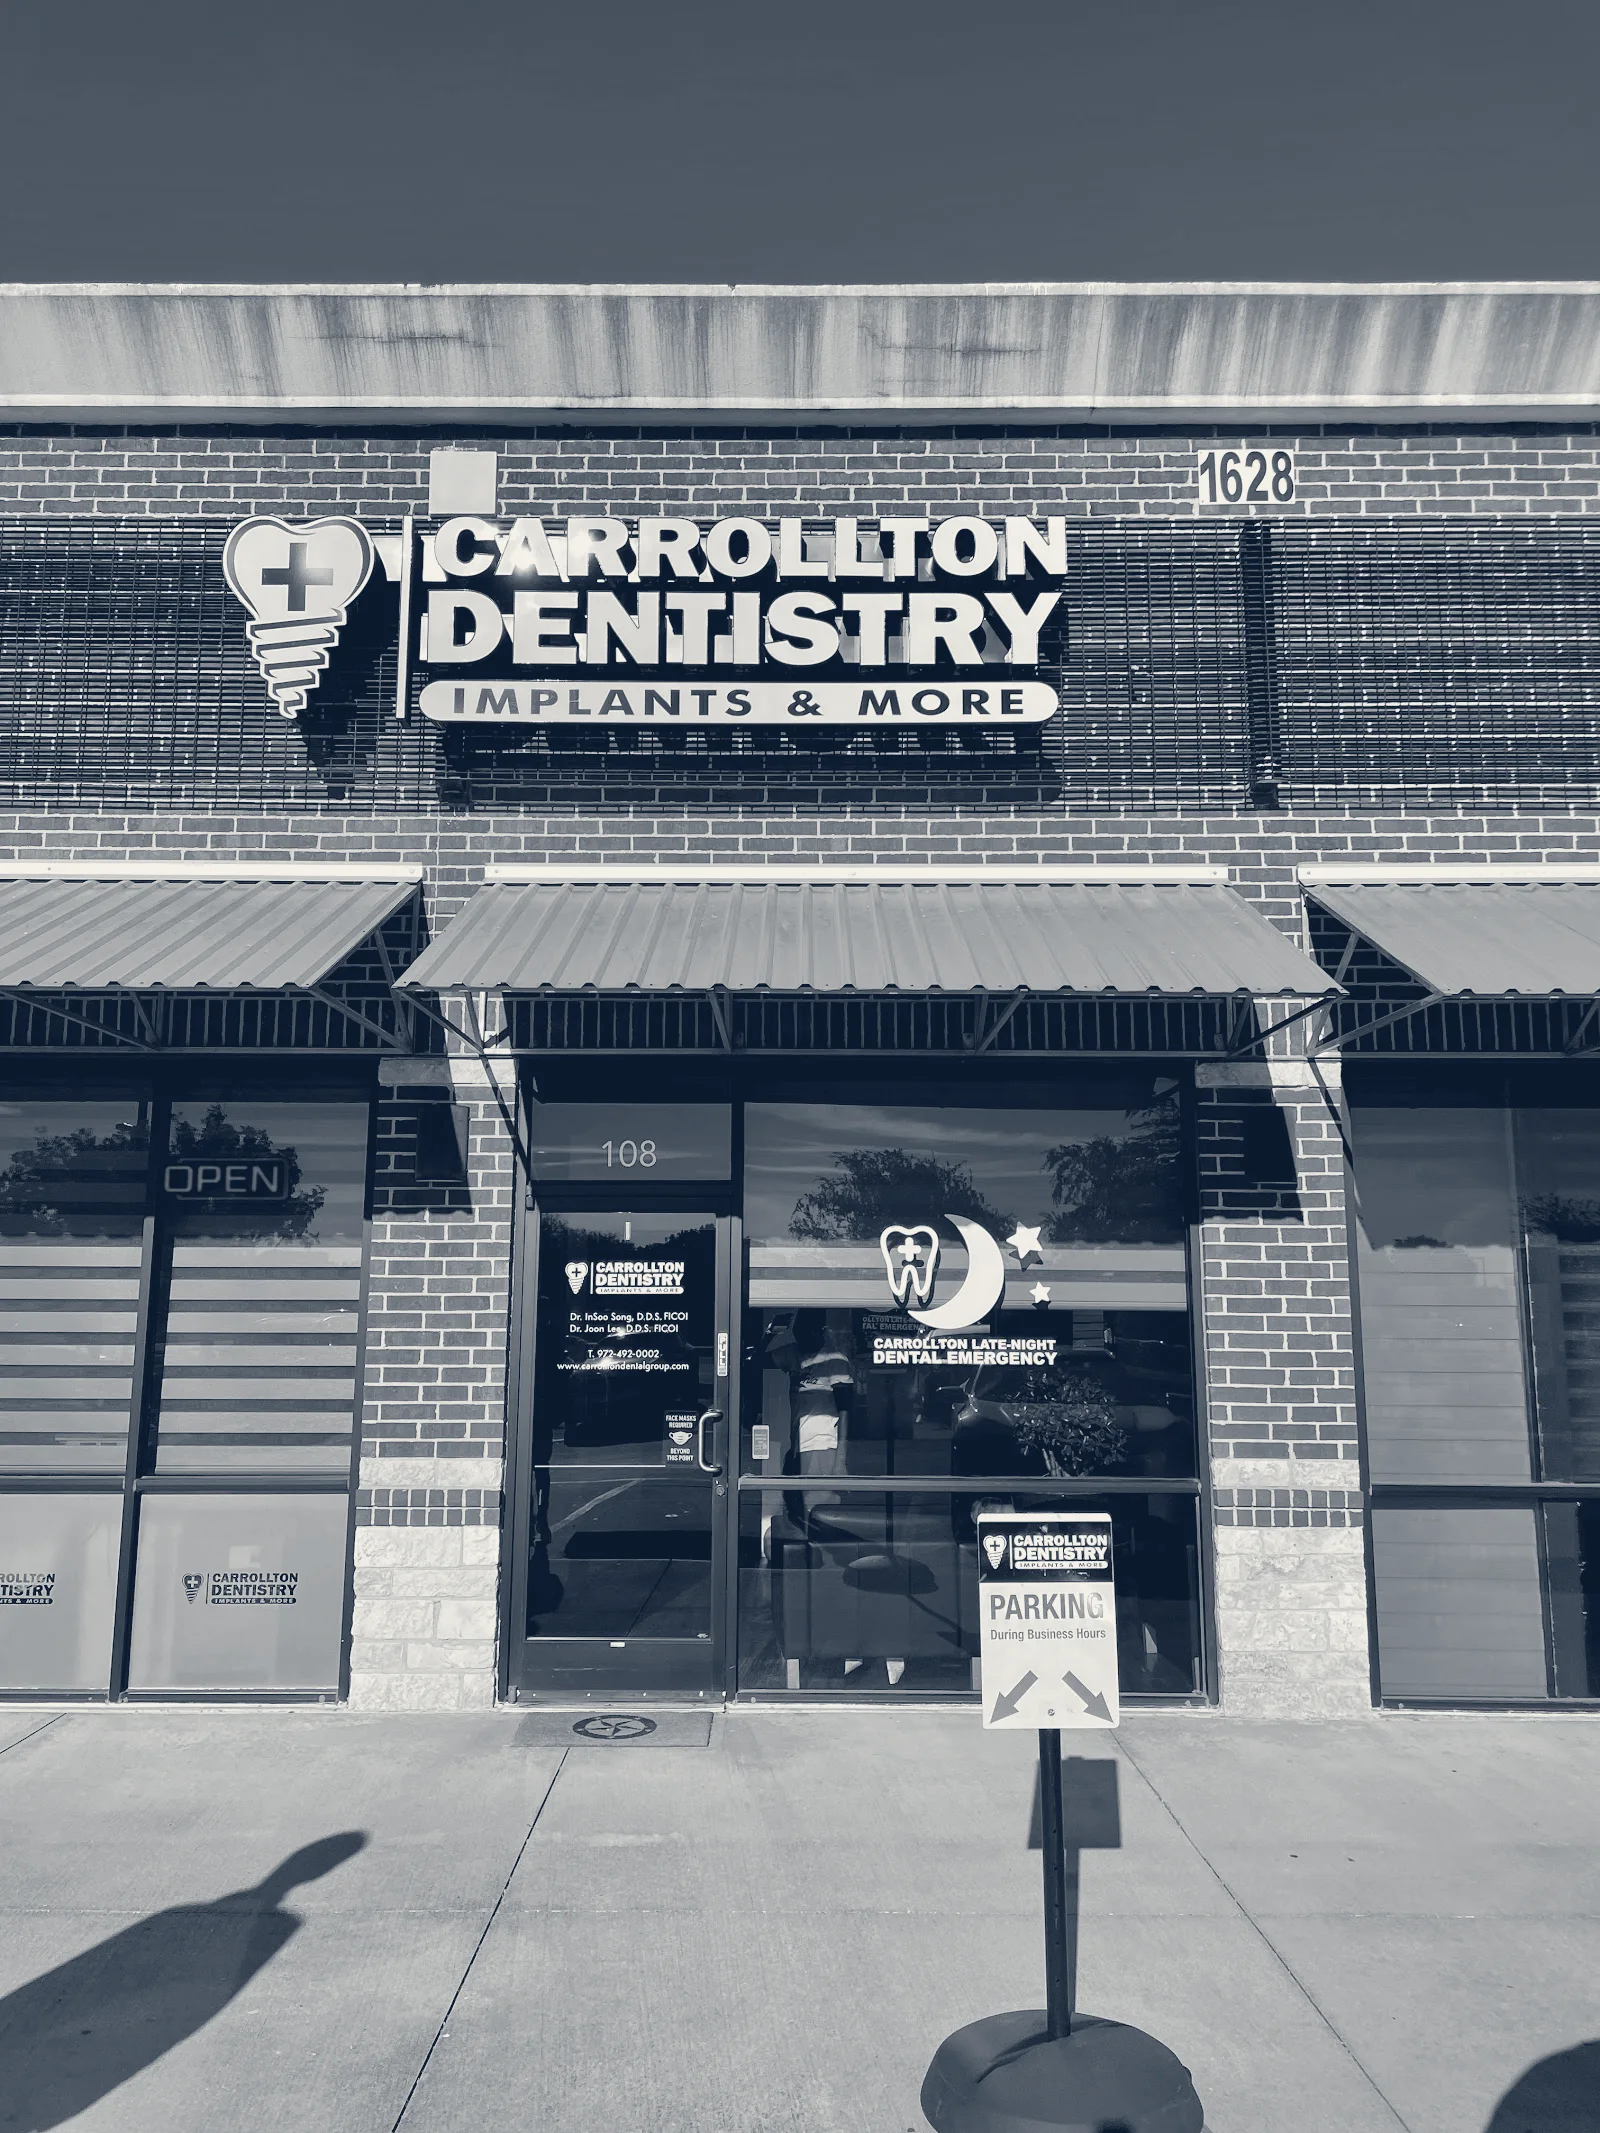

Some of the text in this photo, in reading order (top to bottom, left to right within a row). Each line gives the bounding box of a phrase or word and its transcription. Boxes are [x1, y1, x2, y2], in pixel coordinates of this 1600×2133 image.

[1200, 451, 1294, 502] 1628
[434, 515, 1068, 578] CARROLLTON
[427, 590, 1063, 666] DENTISTRY
[453, 687, 1024, 716] IMPLANTS & MORE
[601, 1139, 657, 1168] 108
[164, 1165, 278, 1193] OPEN
[595, 1262, 685, 1273] CARROLLTON
[595, 1273, 684, 1286] DENTISTRY
[570, 1312, 582, 1321] Dr.
[585, 1312, 608, 1321] InSoo
[610, 1312, 635, 1322] Song,
[636, 1312, 662, 1321] D.D.S.
[570, 1324, 582, 1333] Dr.
[584, 1324, 605, 1333] Joon
[626, 1324, 652, 1333] D.D.S.
[873, 1338, 1057, 1351] CARROLLTON LATE-NIGHT
[587, 1350, 660, 1358] T. 972-492-0002
[873, 1351, 1057, 1366] DENTAL EMERGENCY
[1013, 1535, 1108, 1547] CARROLLTON
[1014, 1547, 1107, 1560] DENTISTRY
[212, 1573, 299, 1583] CARROLLTON
[211, 1584, 297, 1596] DENTISTRY
[990, 1592, 1104, 1620] PARKING
[990, 1628, 1106, 1642] During Business Hours
